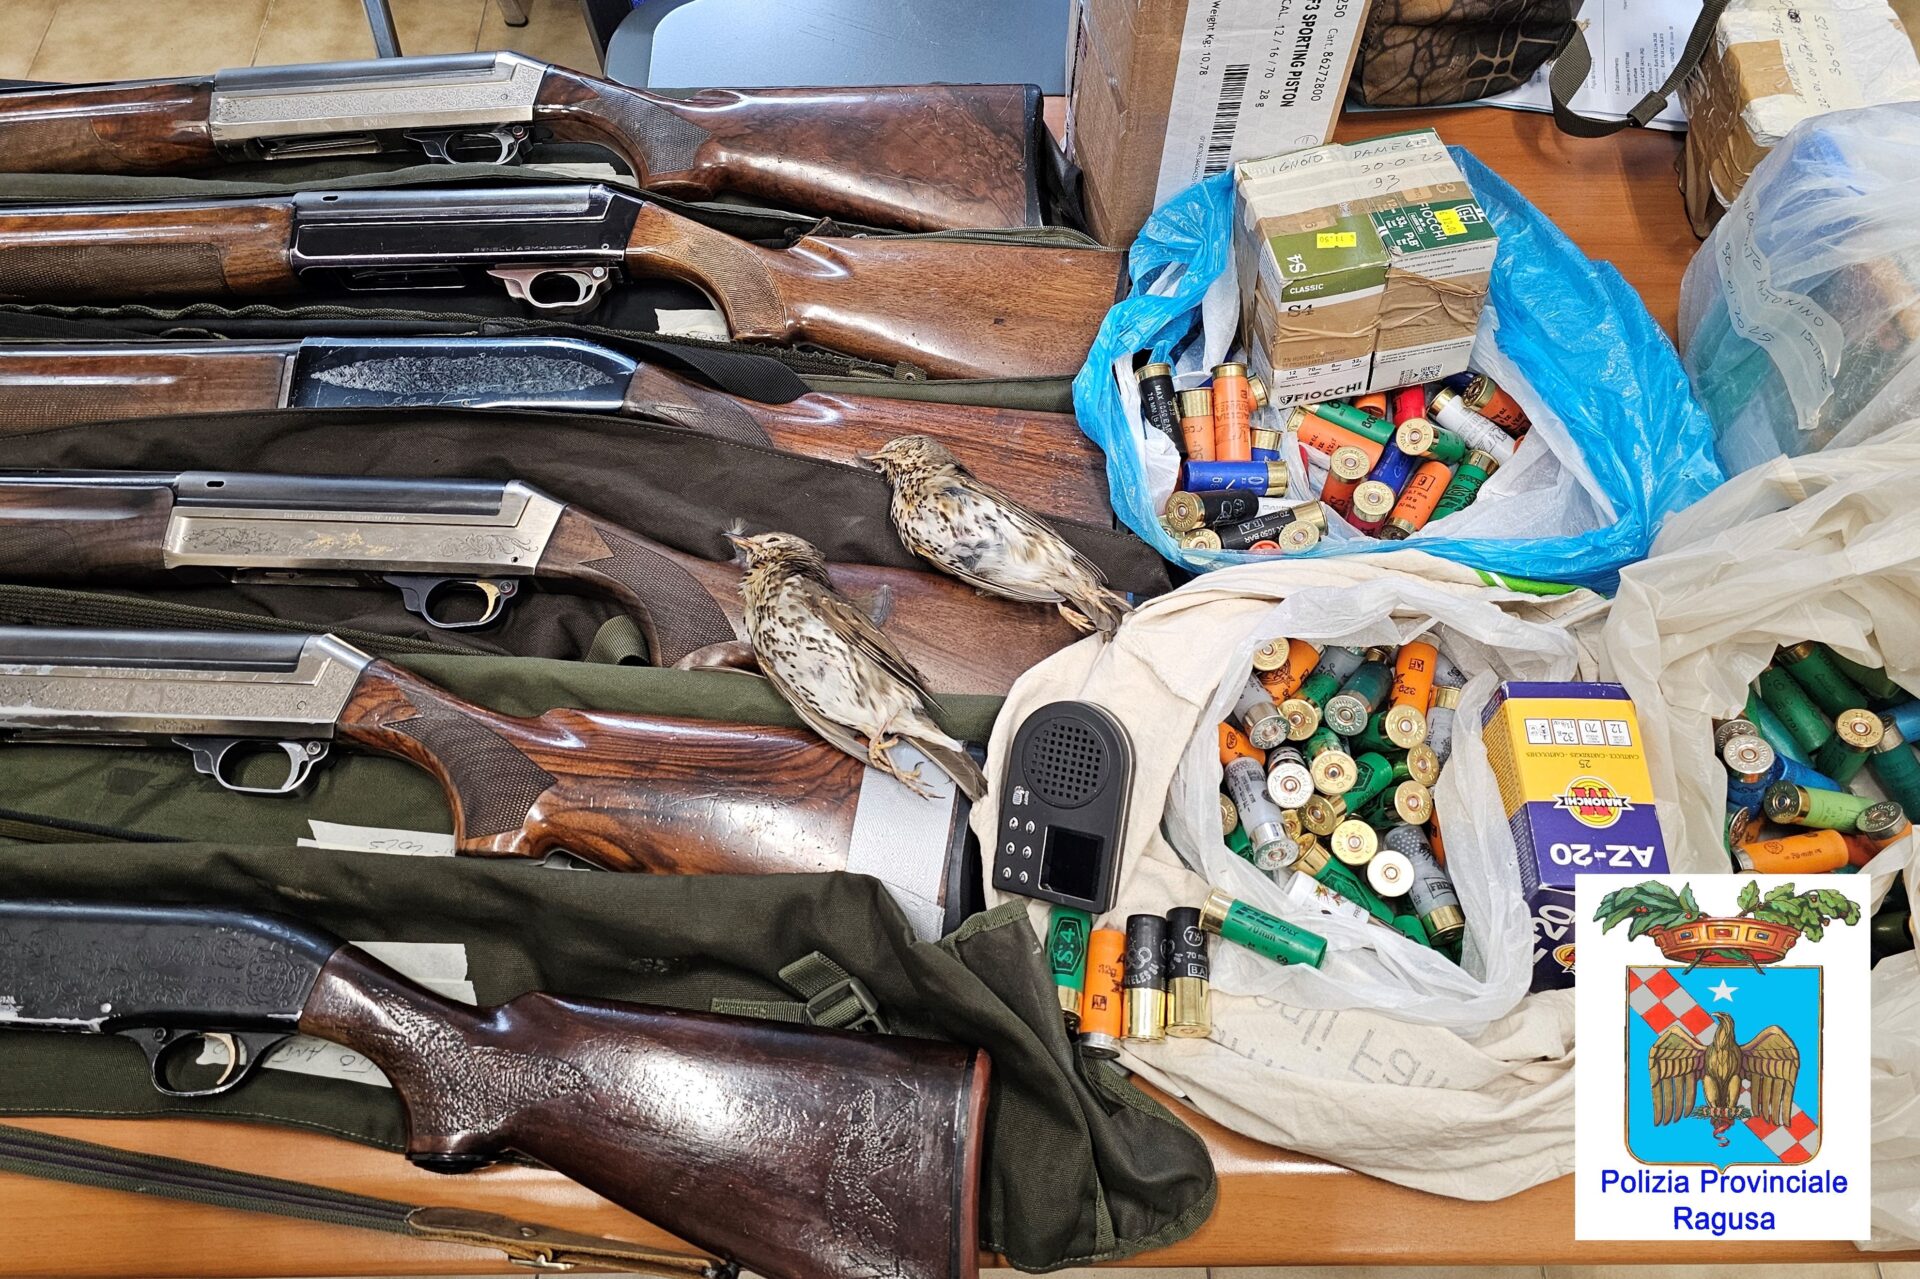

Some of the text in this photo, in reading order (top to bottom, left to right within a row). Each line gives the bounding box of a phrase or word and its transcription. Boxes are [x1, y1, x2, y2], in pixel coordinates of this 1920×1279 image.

[1199, 0, 1221, 76] Weight Kg: 10,78
[1290, 14, 1318, 67] SPORTING
[1323, 28, 1338, 50] Cart.
[1310, 51, 1334, 102] 86272800
[1259, 89, 1271, 100] 28
[1280, 71, 1303, 108] PISTON
[1417, 202, 1447, 241] FIOCCHI
[1287, 253, 1307, 274] S4
[1289, 283, 1324, 295] CLASSIC
[1287, 304, 1313, 318] S4
[1154, 385, 1164, 400] MAX
[1294, 381, 1363, 402] FIOCCHI
[1243, 533, 1260, 544] BAR
[1584, 723, 1598, 733] 70
[1610, 723, 1623, 734] 12
[1578, 759, 1592, 769] 25
[1563, 797, 1623, 807] MAIONCHI
[1550, 843, 1655, 868] AZ-20
[1278, 924, 1299, 937] ITALY
